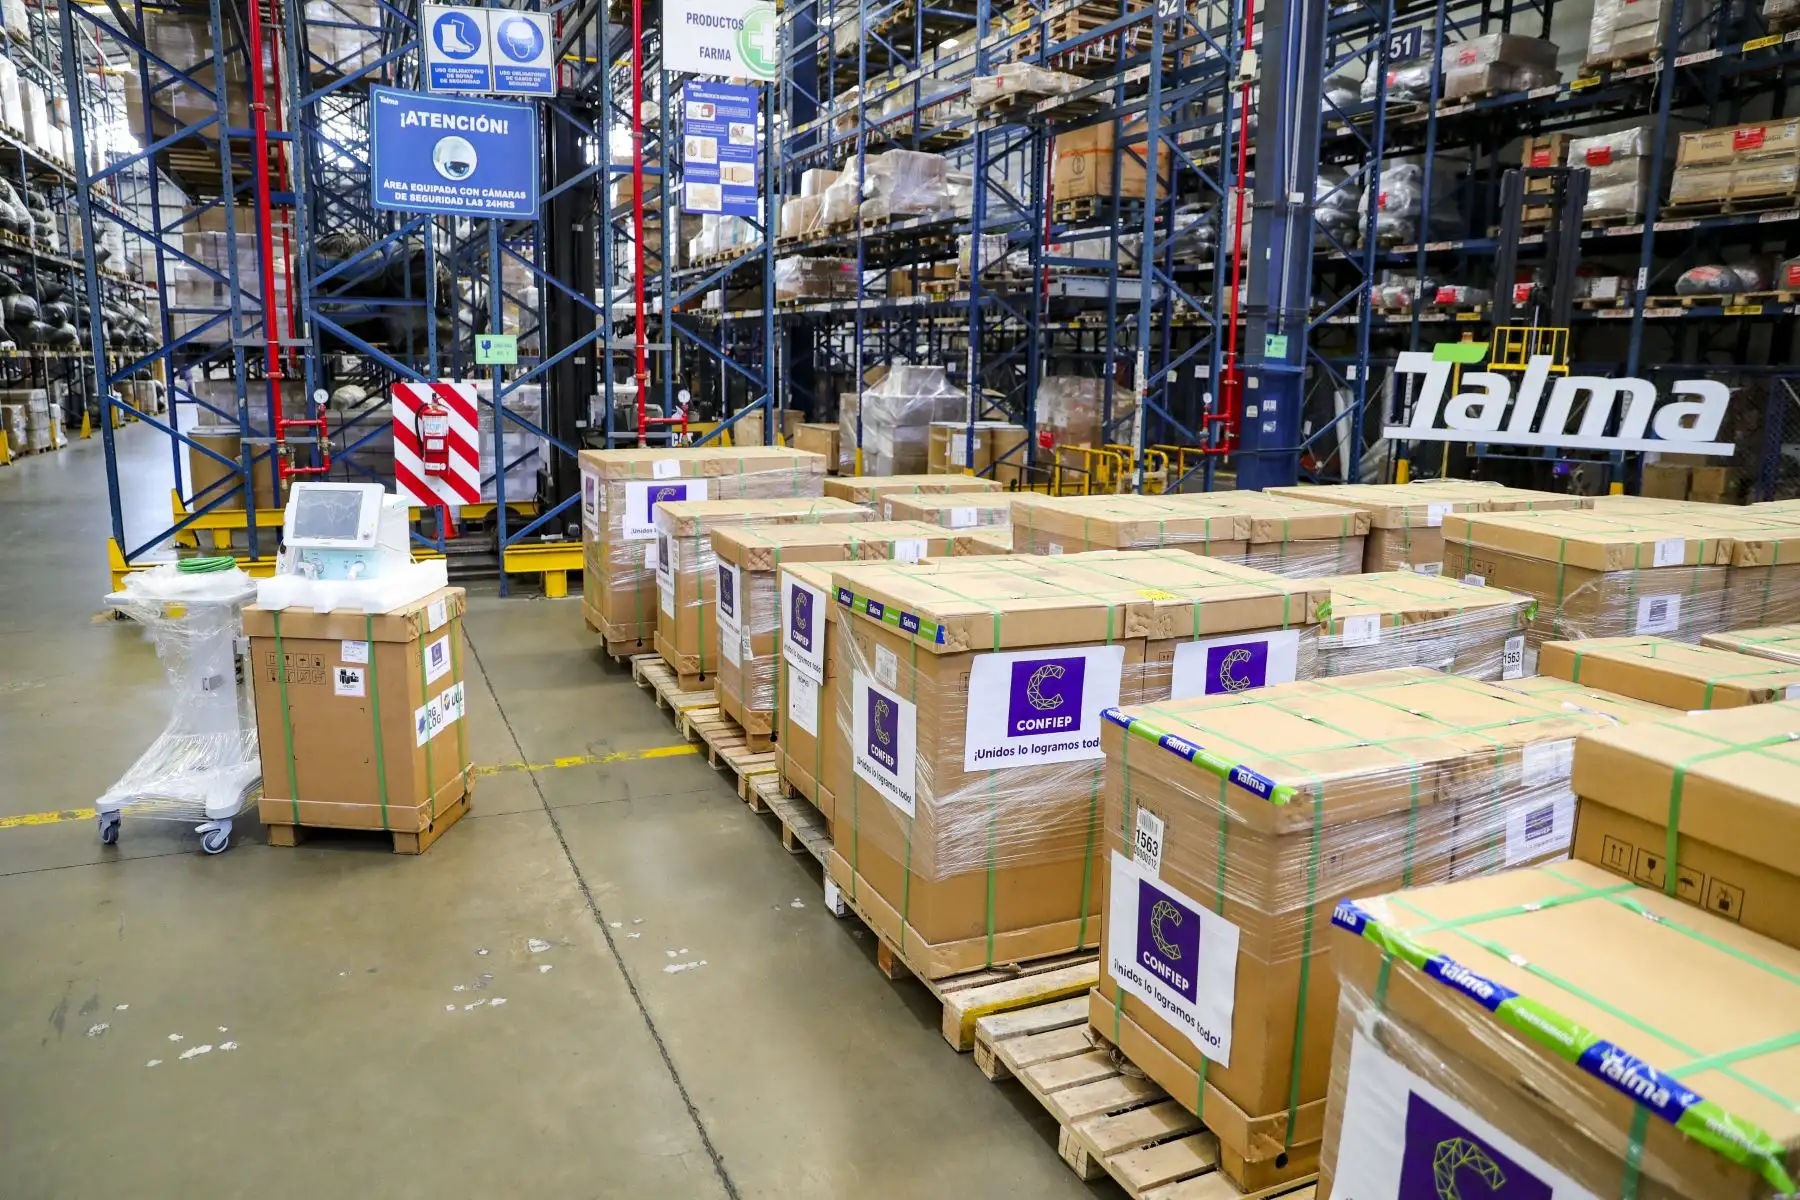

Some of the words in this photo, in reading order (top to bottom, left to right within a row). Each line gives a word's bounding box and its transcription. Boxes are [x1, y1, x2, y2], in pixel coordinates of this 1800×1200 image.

[686, 12, 744, 31] PRODUCTOS
[699, 46, 731, 61] FARMA
[1390, 33, 1411, 58] 51
[379, 95, 399, 106] Talma
[400, 110, 509, 135] ¡ATENCIÓN!
[383, 178, 408, 190] ÁREA
[411, 183, 458, 195] EQUIPADA
[460, 187, 480, 196] CON
[482, 187, 526, 199] CÁMARAS
[394, 192, 407, 201] DE
[409, 194, 463, 206] SEGURIDAD
[466, 198, 483, 207] LAS
[486, 199, 515, 209] 24HRS
[1394, 342, 1732, 441] Talma
[903, 616, 917, 630] Talma
[1503, 651, 1520, 664] 1563
[1016, 716, 1073, 732] CONFIEP
[871, 743, 895, 767] CONFIEP
[974, 746, 1015, 761] ¡Unidos
[1018, 745, 1028, 755] lo
[1031, 741, 1079, 756] logramos
[1082, 736, 1100, 749] tod
[1165, 737, 1191, 756] Talma
[876, 770, 898, 795] logramos
[1237, 768, 1266, 793] Talma
[1135, 828, 1159, 857] 1563
[1143, 951, 1189, 991] CONFIEP
[1144, 980, 1153, 994] lo
[1154, 986, 1195, 1027] logramos
[1196, 1021, 1221, 1049] todo!
[1599, 1048, 1670, 1108] Talma
